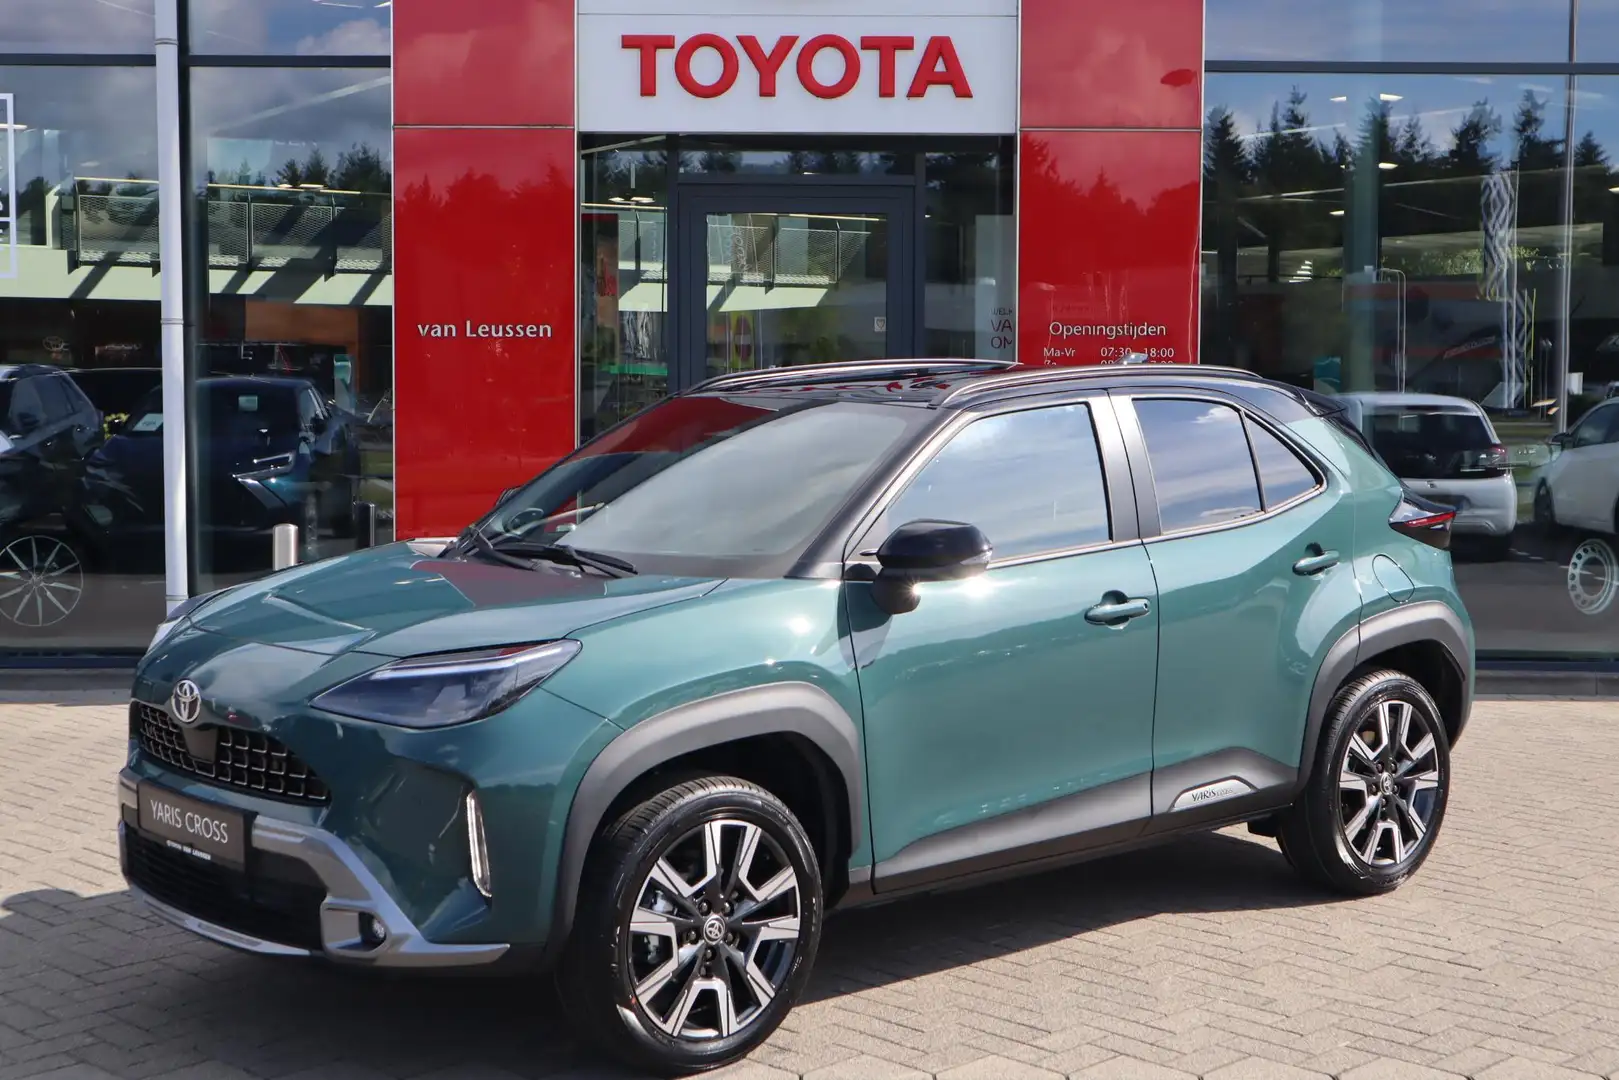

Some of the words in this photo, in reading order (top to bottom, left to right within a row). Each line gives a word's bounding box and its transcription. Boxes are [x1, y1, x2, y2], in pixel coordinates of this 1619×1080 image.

[621, 33, 973, 99] TOYOTA
[417, 323, 457, 337] van
[465, 320, 552, 338] Leussen
[1049, 321, 1167, 340] Openingstijden
[1043, 347, 1076, 357] Ma-Vr
[150, 799, 182, 829] YARIS
[185, 811, 229, 844] CROSS
